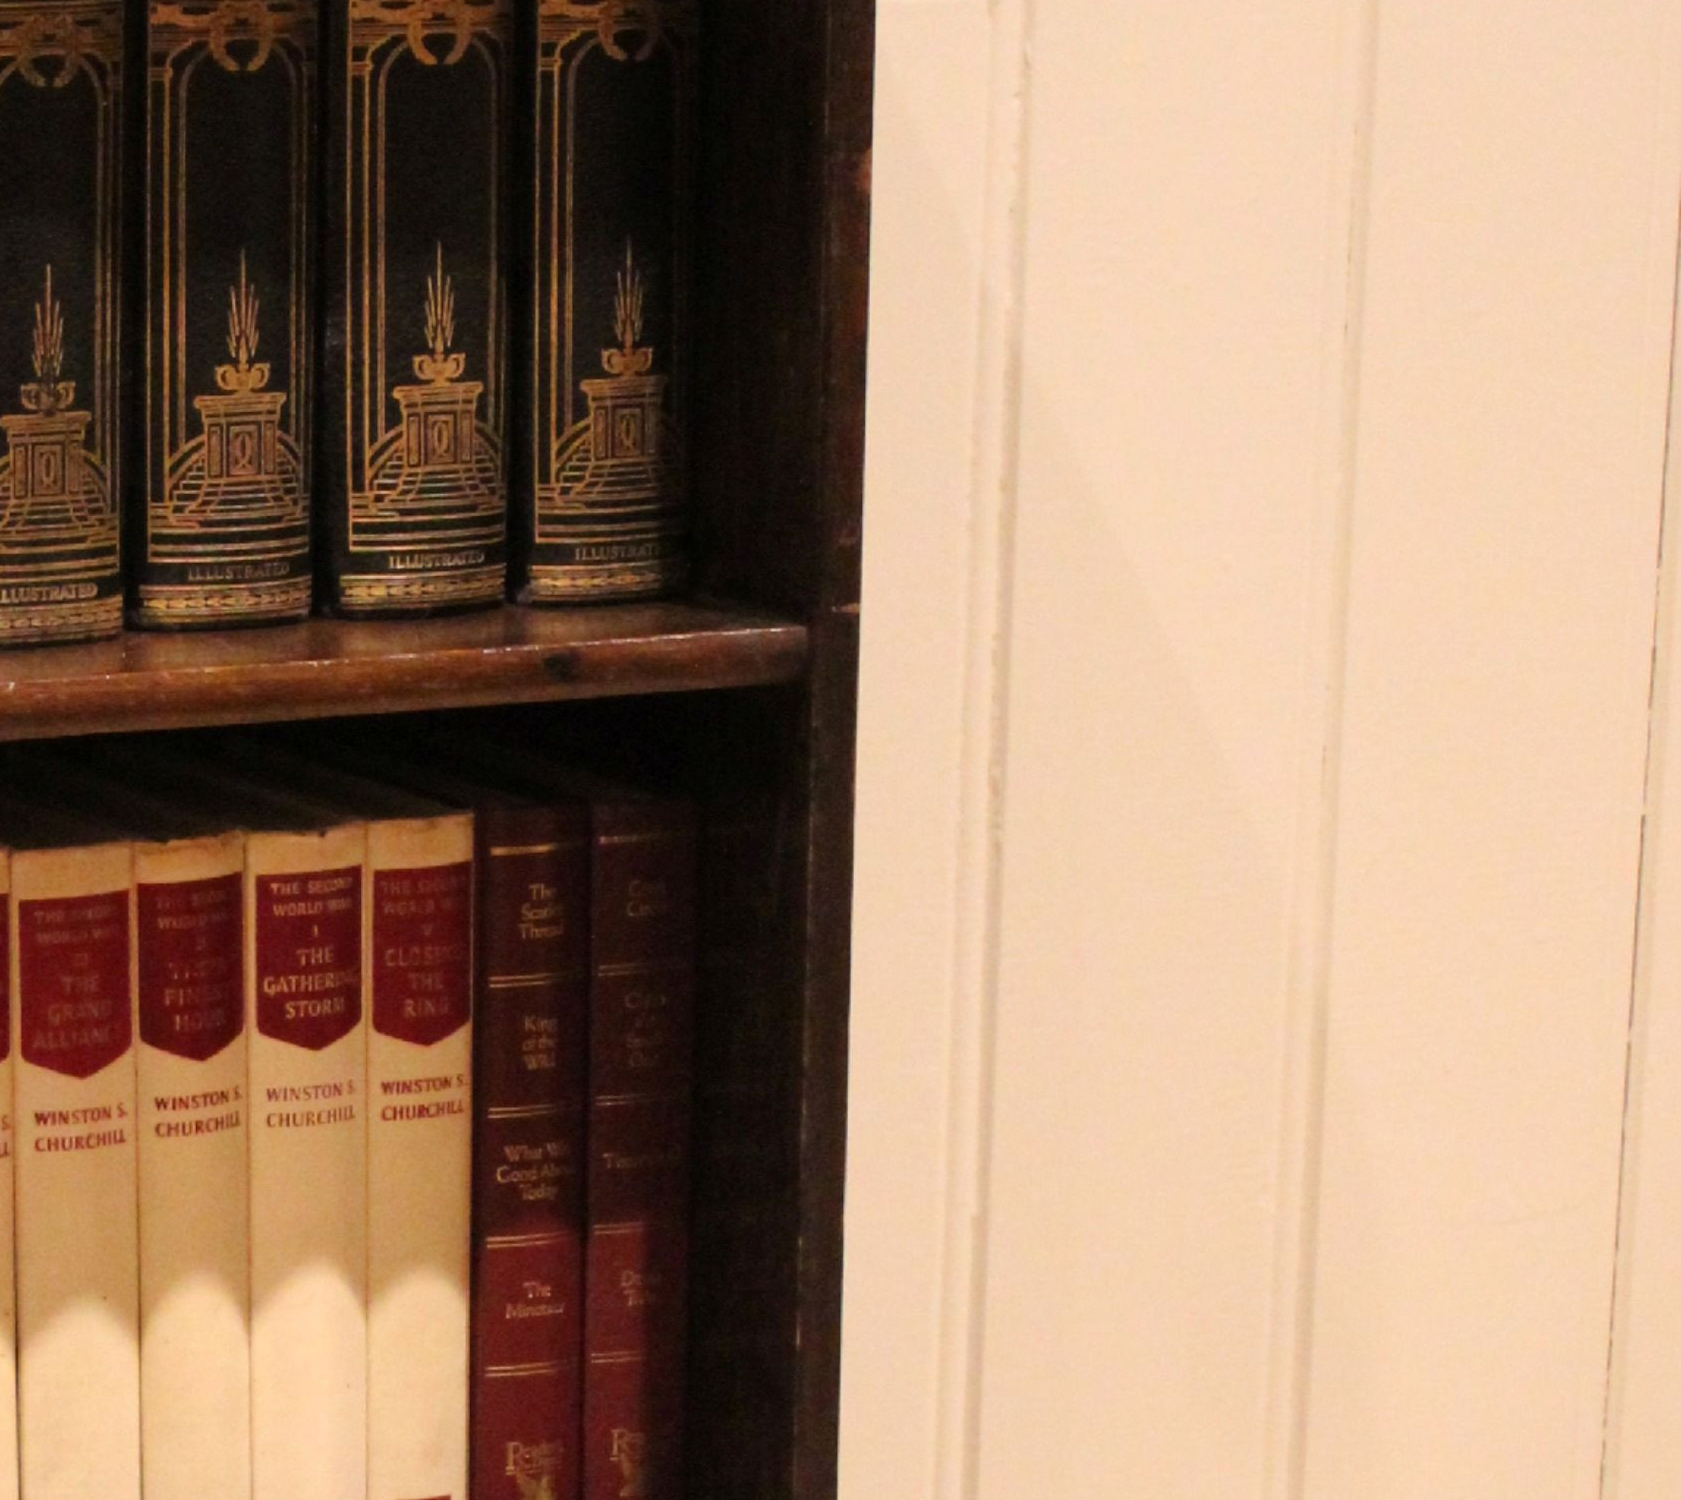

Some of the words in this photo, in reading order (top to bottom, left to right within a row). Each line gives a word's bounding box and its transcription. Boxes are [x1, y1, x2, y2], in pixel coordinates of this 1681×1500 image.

[388, 550, 485, 570] ILLUSTRATED
[574, 543, 662, 564] ILLUSTRAT
[187, 561, 290, 582] ILLUSTRATED
[296, 944, 335, 966] THE
[284, 998, 346, 1021] STORM
[266, 1083, 341, 1103] WINSTON
[380, 1076, 453, 1096] WINSTON
[153, 1091, 229, 1112] WINSTON
[381, 1099, 465, 1121] CHURCHILL
[33, 1106, 111, 1127] WINSTON
[154, 1109, 241, 1138] CHURCHILL
[266, 1104, 356, 1129] CHURCHILL
[34, 1129, 127, 1152] CHURCHILL
